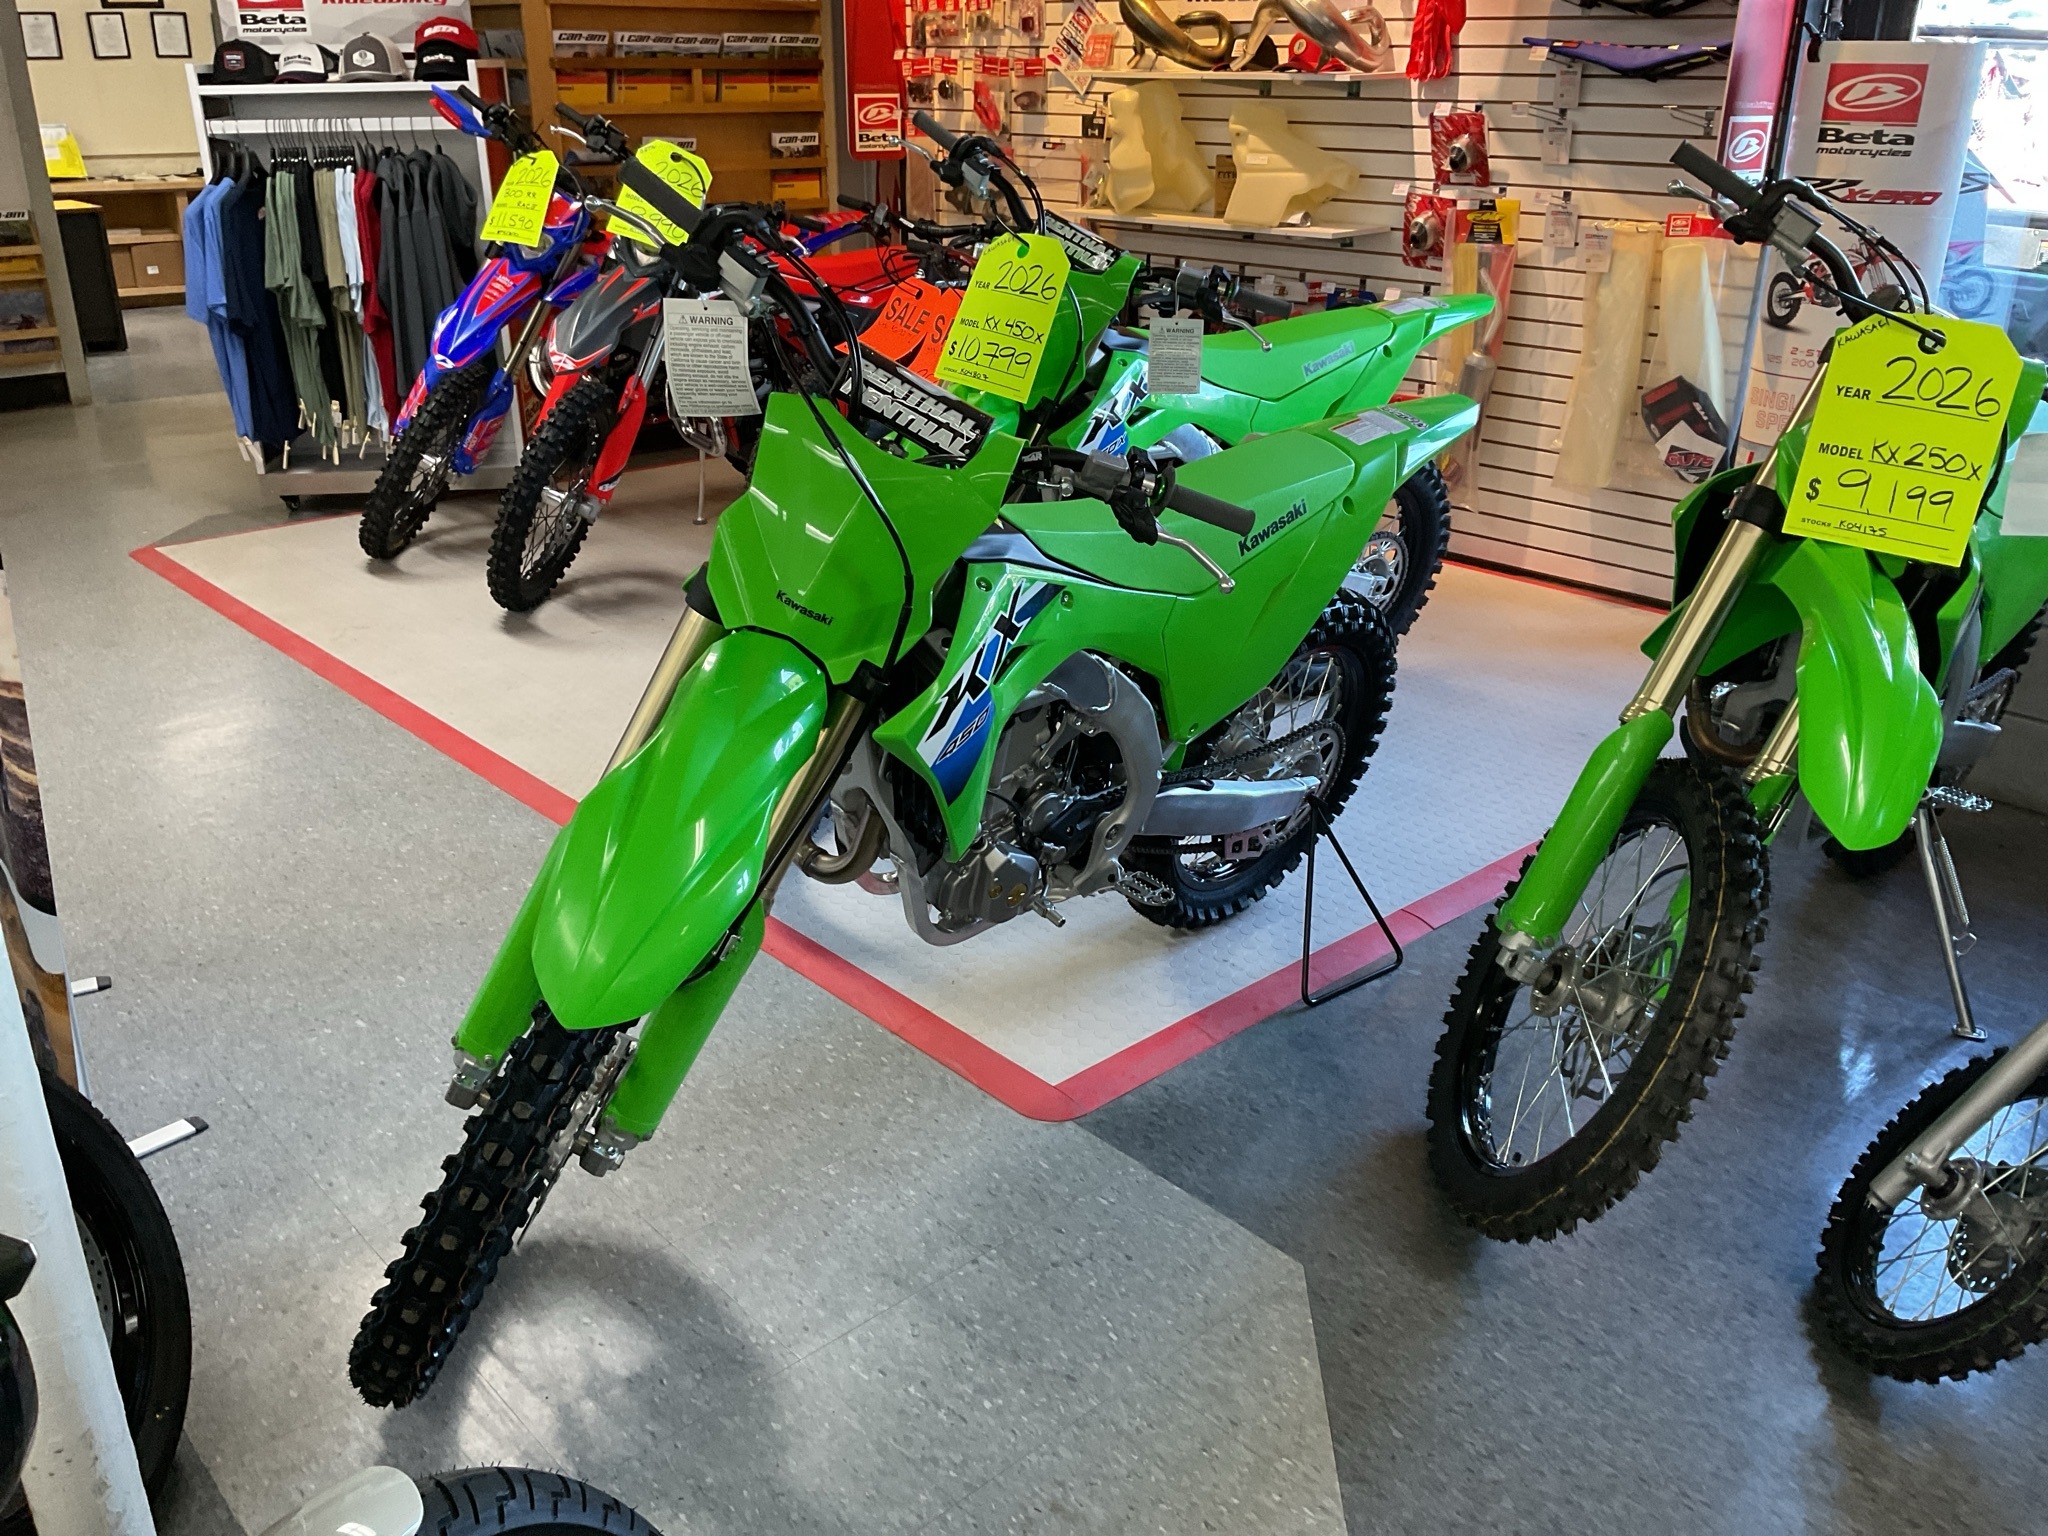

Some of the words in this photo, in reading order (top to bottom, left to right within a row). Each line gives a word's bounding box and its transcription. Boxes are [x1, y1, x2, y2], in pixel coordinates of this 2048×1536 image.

[240, 13, 306, 25] Beta
[1817, 127, 1915, 146] Beta
[1816, 147, 1912, 158] motorcycles
[516, 167, 552, 188] 2026
[975, 280, 990, 289] YEAR
[994, 261, 1057, 300] 2026
[690, 316, 733, 325] WARNING
[885, 297, 930, 334] SALE
[960, 318, 979, 328] MODEL
[1837, 318, 1889, 348] KAWASAKI
[1303, 341, 1355, 377] Kawasaki
[1791, 358, 1815, 368] 200
[1836, 385, 1871, 400] YEAR
[1882, 356, 2001, 417] 2026
[861, 358, 977, 440] RENTHAL
[1751, 387, 1795, 411] SINGL
[1756, 410, 1789, 431] SPE
[1665, 453, 1715, 468] GUTS
[1818, 443, 1864, 460] MODEL
[1238, 498, 1307, 557] Kawasaki
[1839, 520, 1888, 537] K04175
[776, 590, 834, 626] Kawasaki
[936, 705, 991, 764] 450
